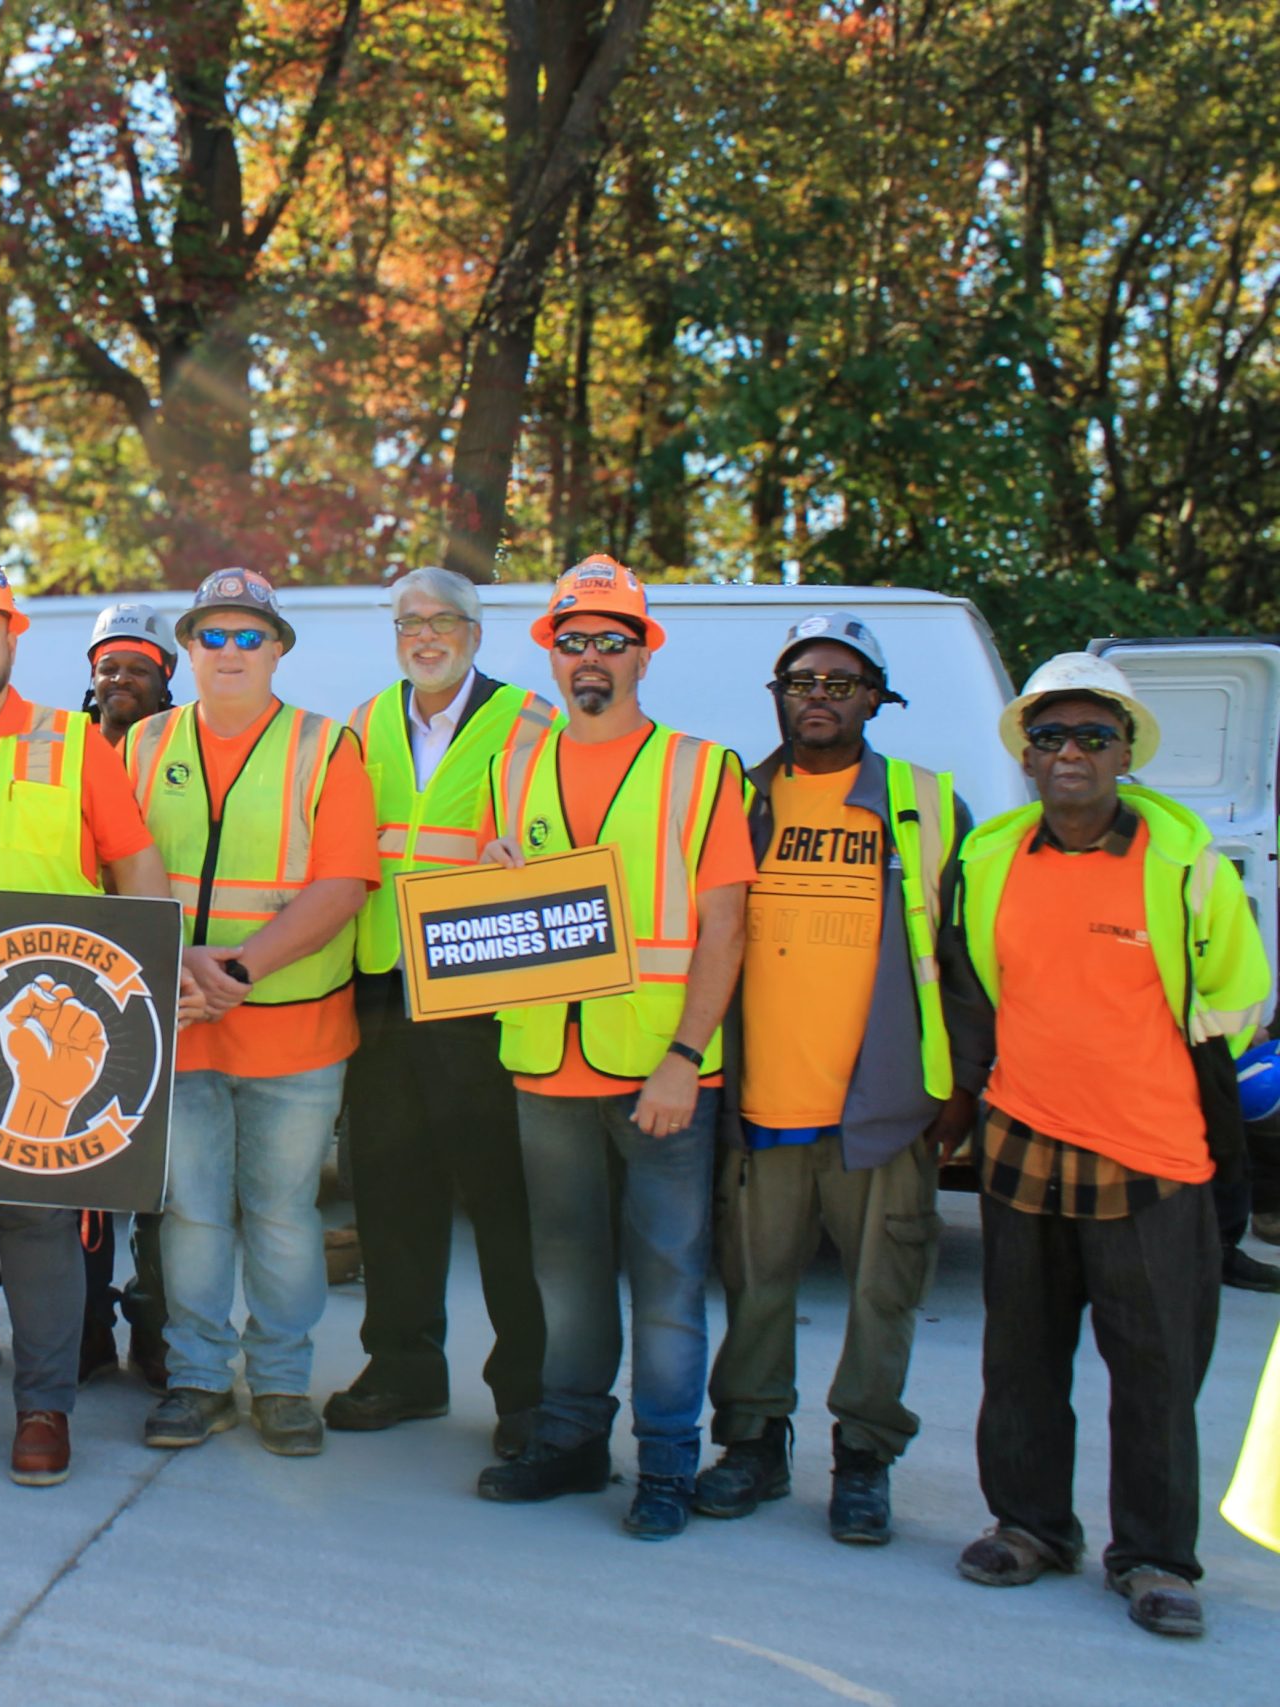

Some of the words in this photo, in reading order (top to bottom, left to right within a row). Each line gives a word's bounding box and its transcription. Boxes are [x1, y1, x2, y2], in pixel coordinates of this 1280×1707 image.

[776, 827, 878, 865] GRETCH
[425, 910, 538, 945] PROMISES
[542, 899, 607, 929] MADE
[428, 932, 547, 967] PROMISES
[550, 922, 608, 950] KEPT
